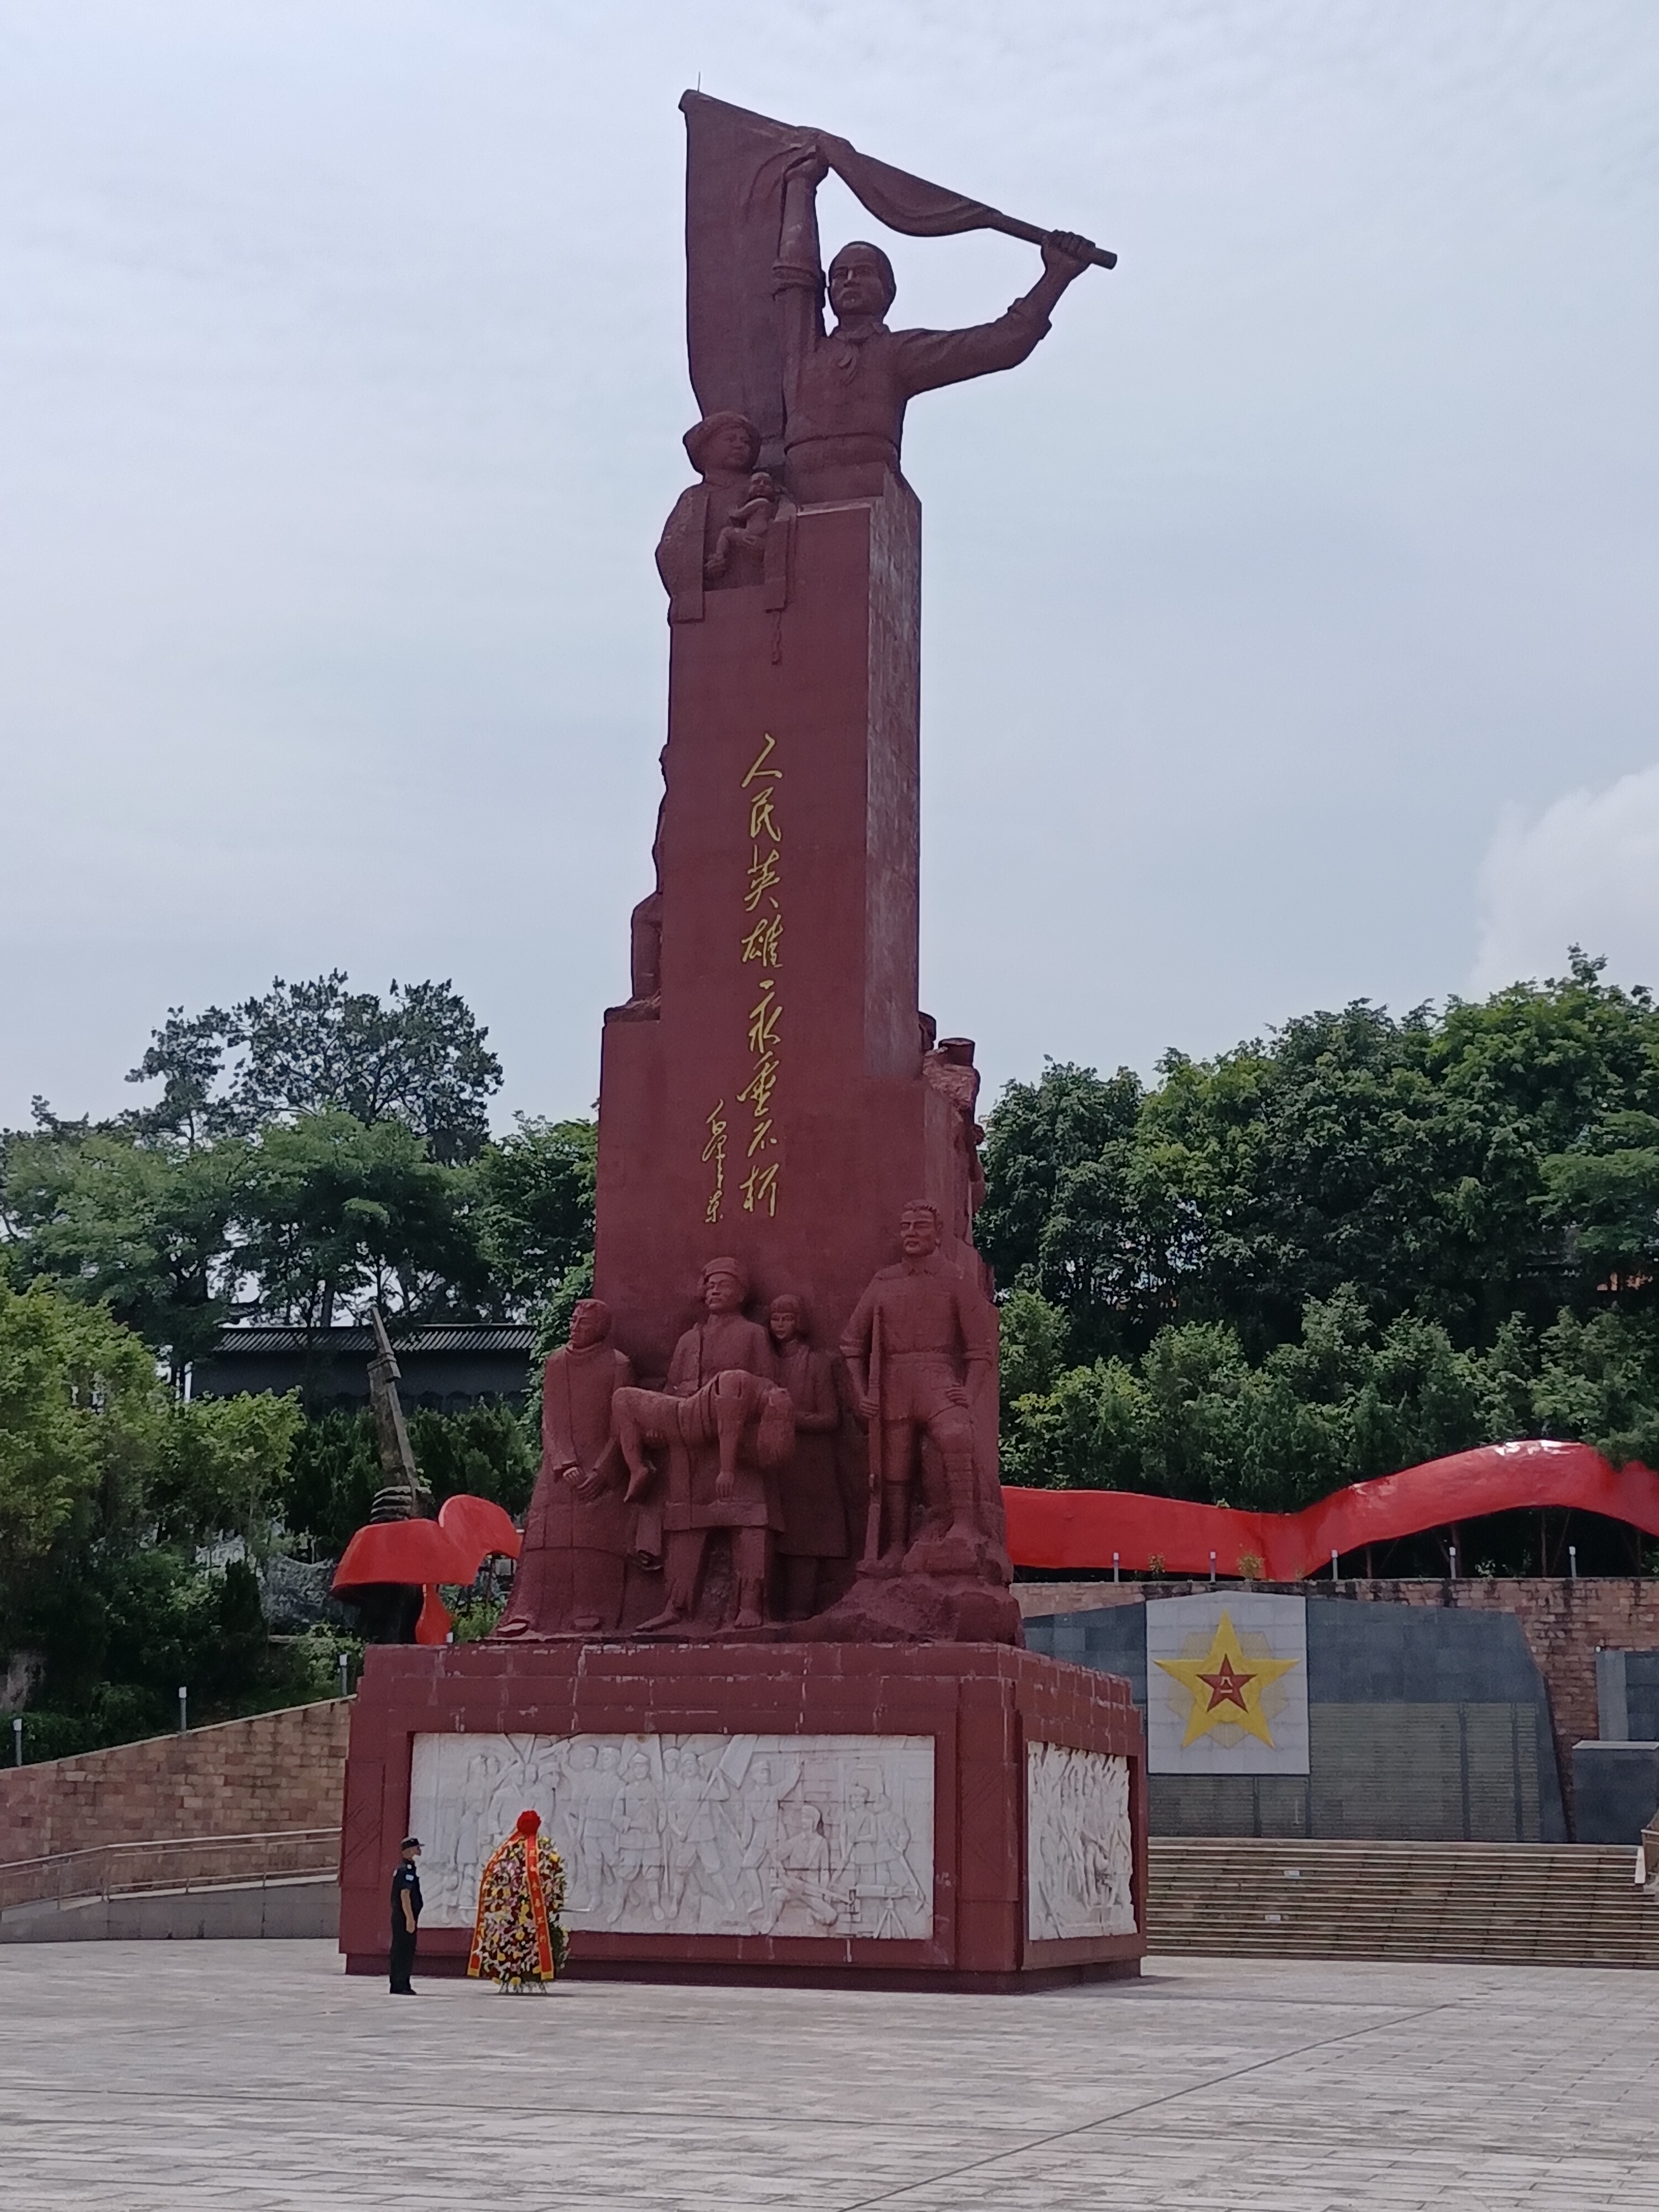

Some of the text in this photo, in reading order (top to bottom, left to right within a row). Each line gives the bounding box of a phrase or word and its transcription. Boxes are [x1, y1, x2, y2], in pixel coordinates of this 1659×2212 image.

[736, 733, 783, 1217] 人民英雄永垂不朽
